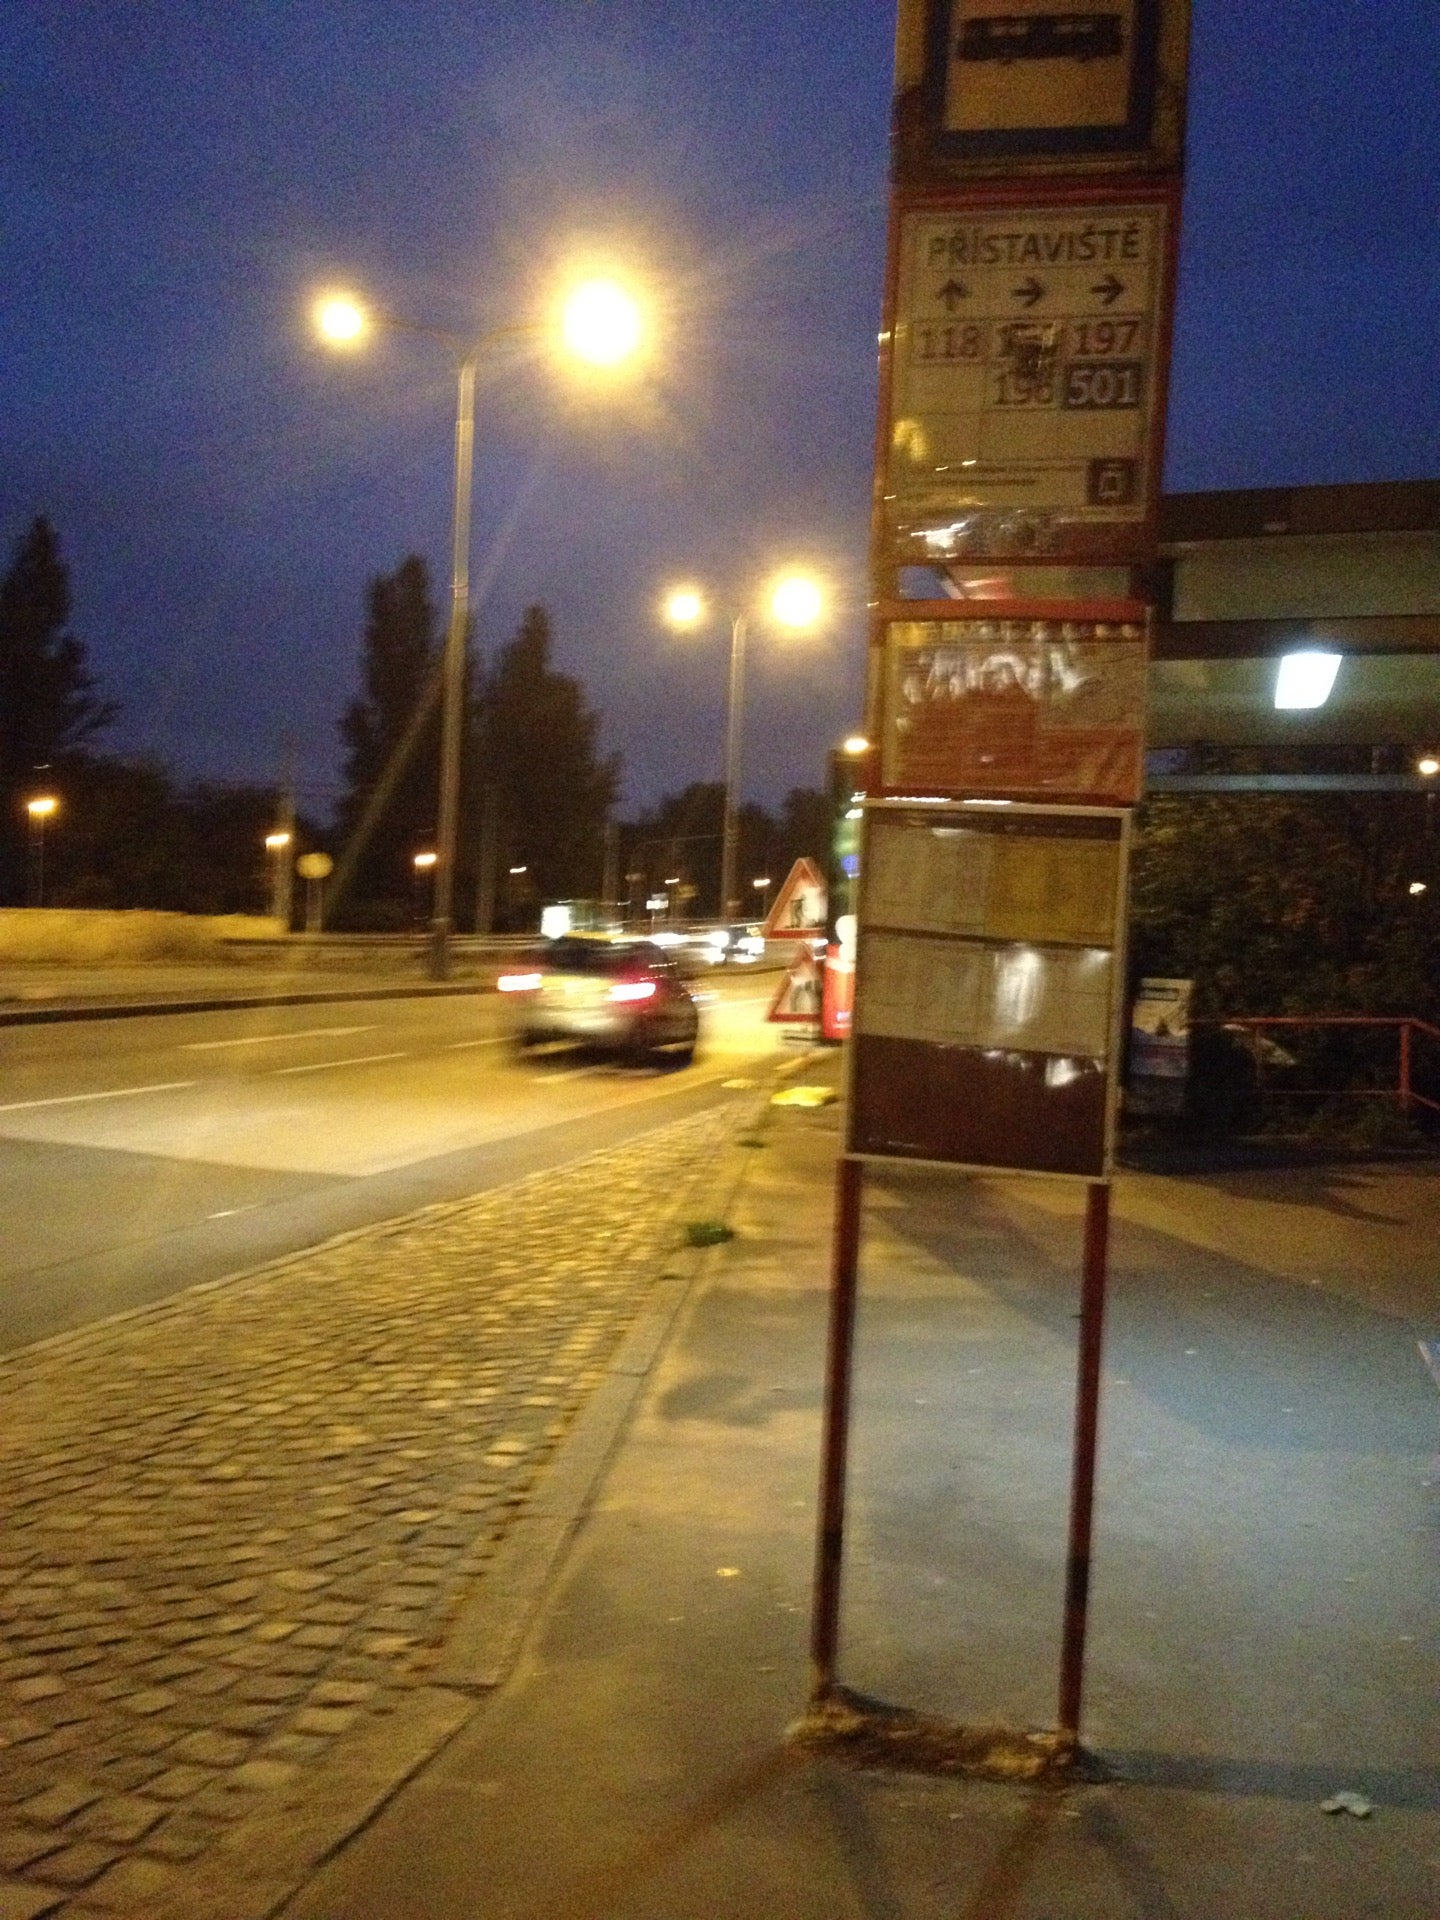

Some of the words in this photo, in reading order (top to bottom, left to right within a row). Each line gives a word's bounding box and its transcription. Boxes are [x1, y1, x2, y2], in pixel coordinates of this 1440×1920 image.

[920, 326, 979, 359] 118
[1075, 320, 1140, 354] 197
[1068, 368, 1136, 405] 501
